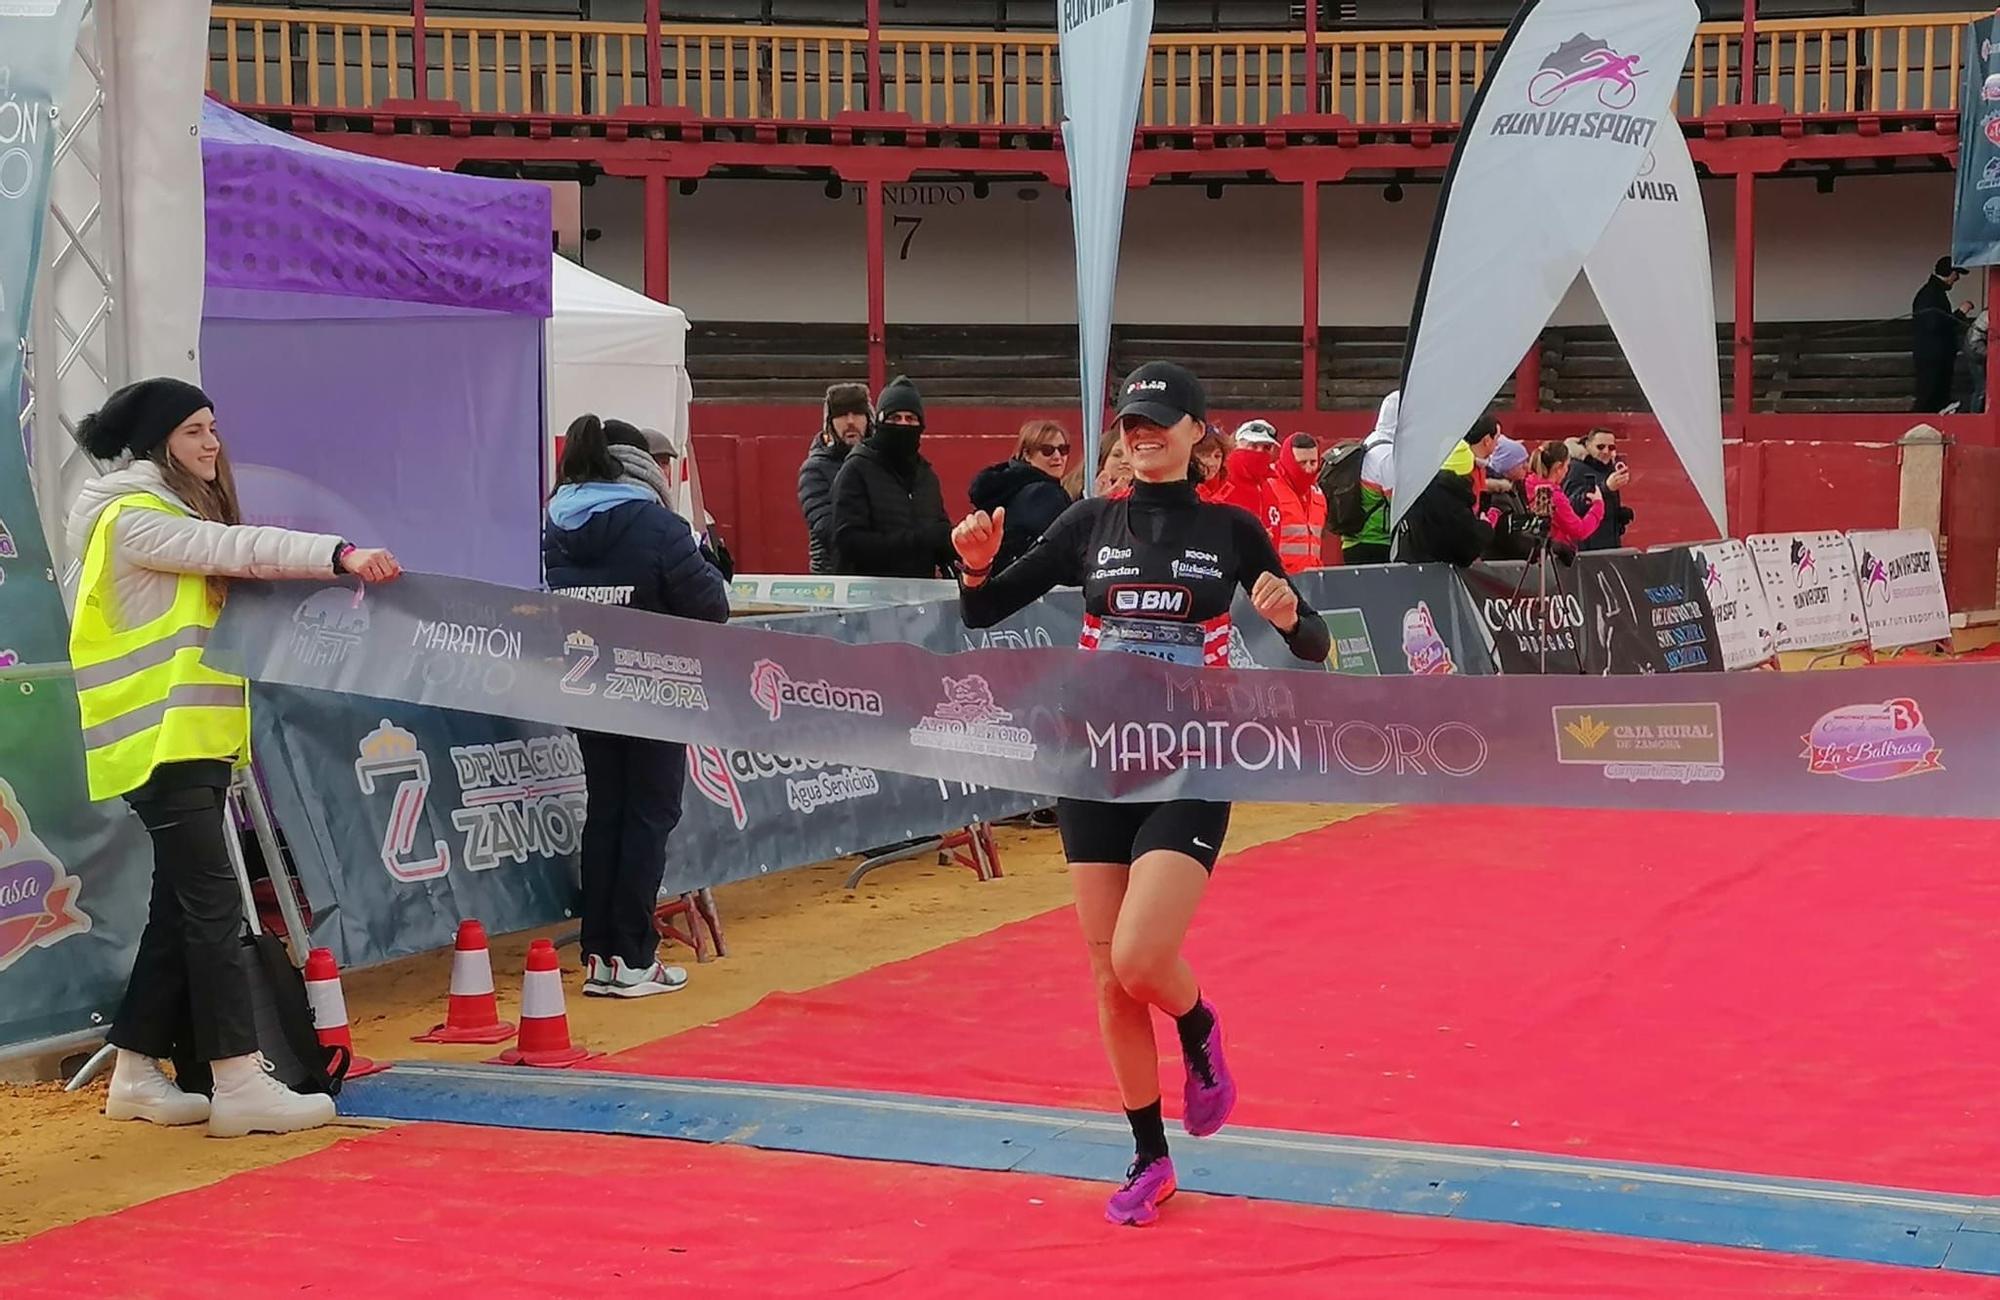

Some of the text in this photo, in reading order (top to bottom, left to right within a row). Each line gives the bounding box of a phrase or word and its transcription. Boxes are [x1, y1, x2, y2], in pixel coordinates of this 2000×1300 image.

[1490, 112, 1657, 148] RUNVASPORT
[852, 185, 965, 206] TNDIDO
[893, 215, 922, 260] 7
[1127, 380, 1167, 395] POLAR
[1142, 590, 1183, 612] BM
[412, 619, 521, 660] MARATÓN
[603, 673, 709, 711] ZAMORA
[781, 679, 881, 713] acciona
[1164, 671, 1296, 719] MEDIA
[1085, 717, 1301, 772] MARATÓN
[1304, 719, 1488, 777] TORO
[1613, 724, 1714, 739] CAJA RURAL
[789, 769, 876, 808] Agua Servicios
